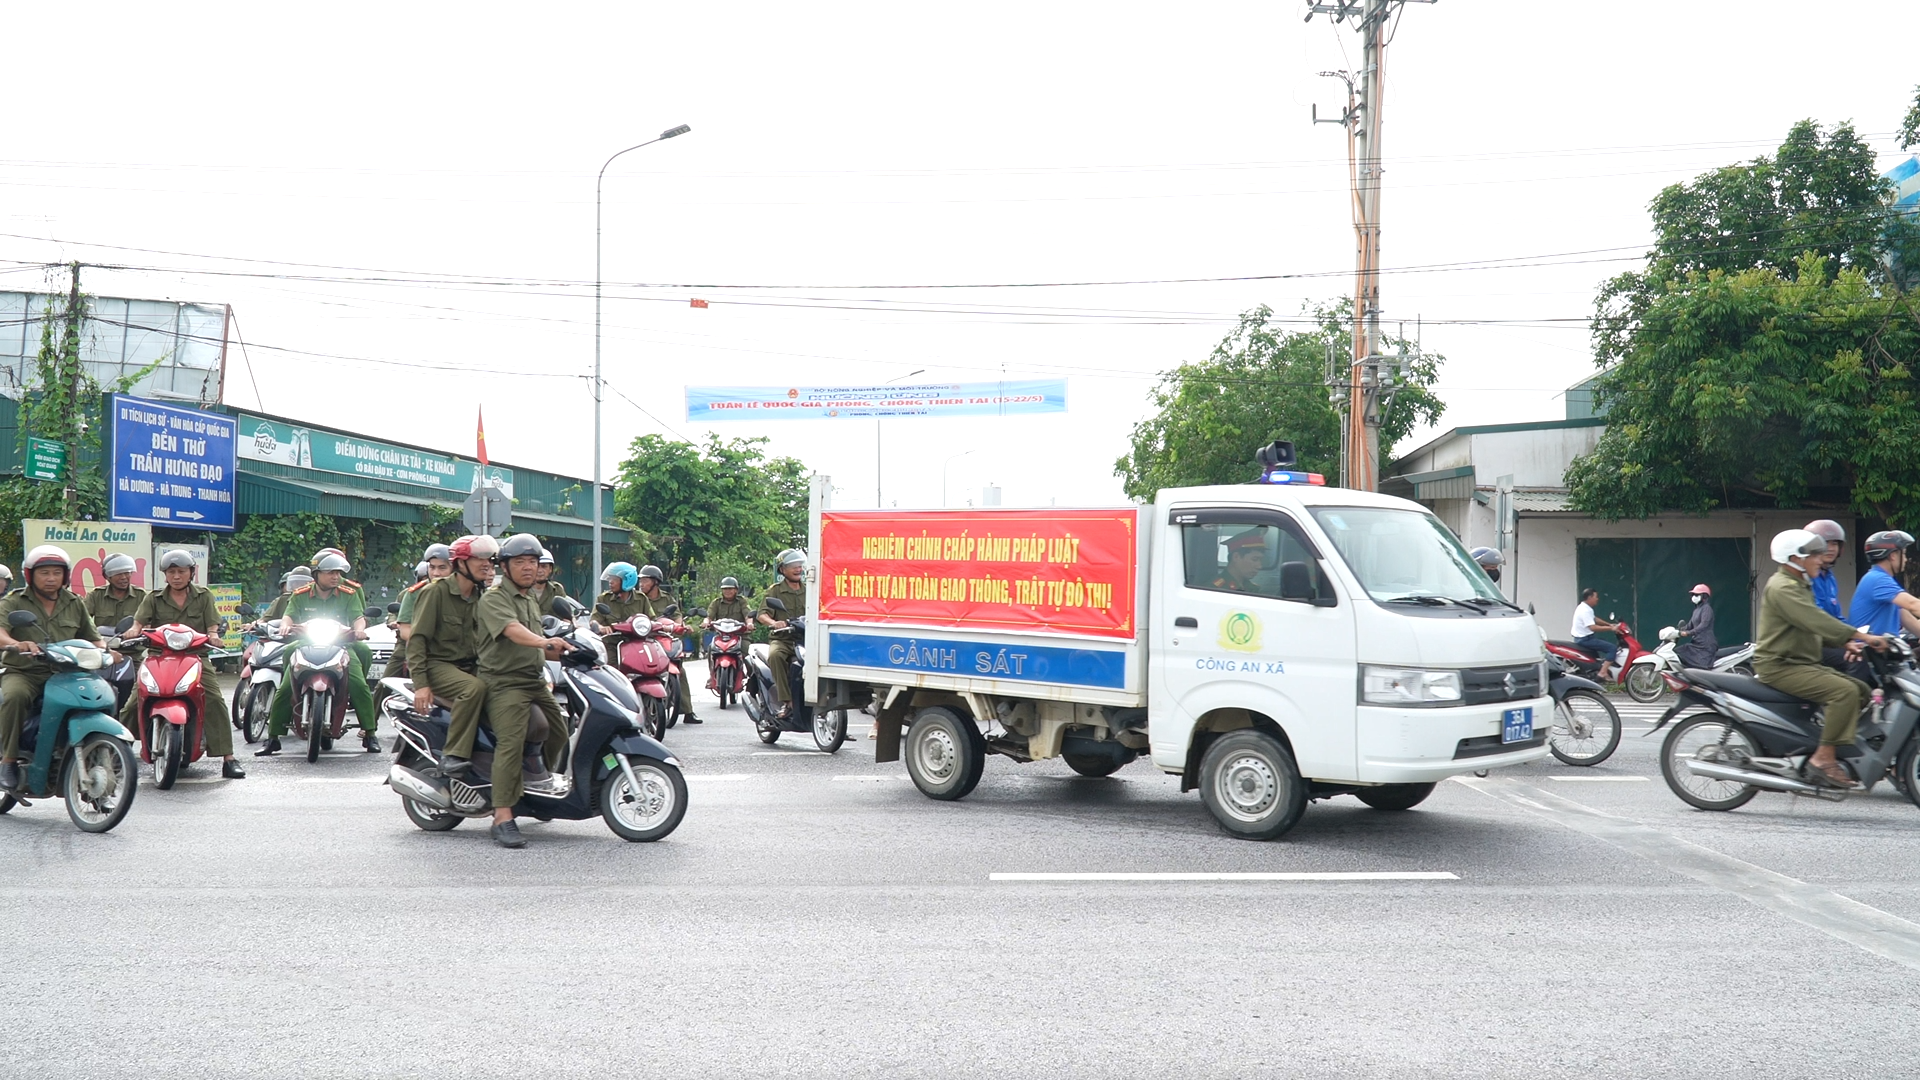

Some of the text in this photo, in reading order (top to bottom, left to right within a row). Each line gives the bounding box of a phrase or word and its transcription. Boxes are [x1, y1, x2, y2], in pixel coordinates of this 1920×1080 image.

[121, 408, 128, 420] DI
[129, 407, 143, 422] TÍCH
[143, 412, 157, 427] LỊCH
[158, 411, 167, 427] SỬ
[170, 415, 182, 430] VĂN
[182, 418, 194, 432] HÓA
[195, 418, 206, 434] CẤP
[206, 422, 220, 437] QUỐC
[220, 426, 230, 439] GIA
[152, 428, 206, 457] ĐỀN THỜ
[335, 439, 357, 458] ĐIỂM
[357, 443, 380, 462] DỪNG
[380, 448, 400, 466] CHÂN
[400, 454, 410, 467] XE
[410, 453, 421, 469] TẢI
[425, 459, 434, 471] XE
[434, 459, 455, 476] KHÁCH
[130, 450, 223, 484] TRẦN HƯNG ĐẠO
[355, 460, 364, 472] CÓ
[364, 463, 374, 475] BÃI
[374, 465, 386, 478] ĐẬU
[386, 468, 394, 477] XE
[396, 468, 408, 480] CƠM
[408, 470, 426, 483] PHÒNG
[426, 473, 440, 486] LẠNH
[119, 476, 129, 492] HÀ
[130, 479, 154, 494] DƯƠNG
[160, 481, 170, 496] HÀ
[171, 484, 192, 499] TRUNG
[198, 488, 218, 502] THANH
[218, 488, 231, 503] HÓA
[152, 506, 170, 519] 800M
[44, 526, 136, 543] Hoài An Quán
[862, 528, 1080, 569] NGHIÊM CHỈNH CHẤP HÀNH PHÁP LUẬT
[835, 567, 1112, 615] VỀ TRẬT TỰ AN TOÀN GIAO THÔNG, TRẬT TỰ ĐÔ THỊ!
[888, 639, 1028, 675] CẢNH SÁT
[1196, 656, 1285, 674] CÔNG AN XÃ
